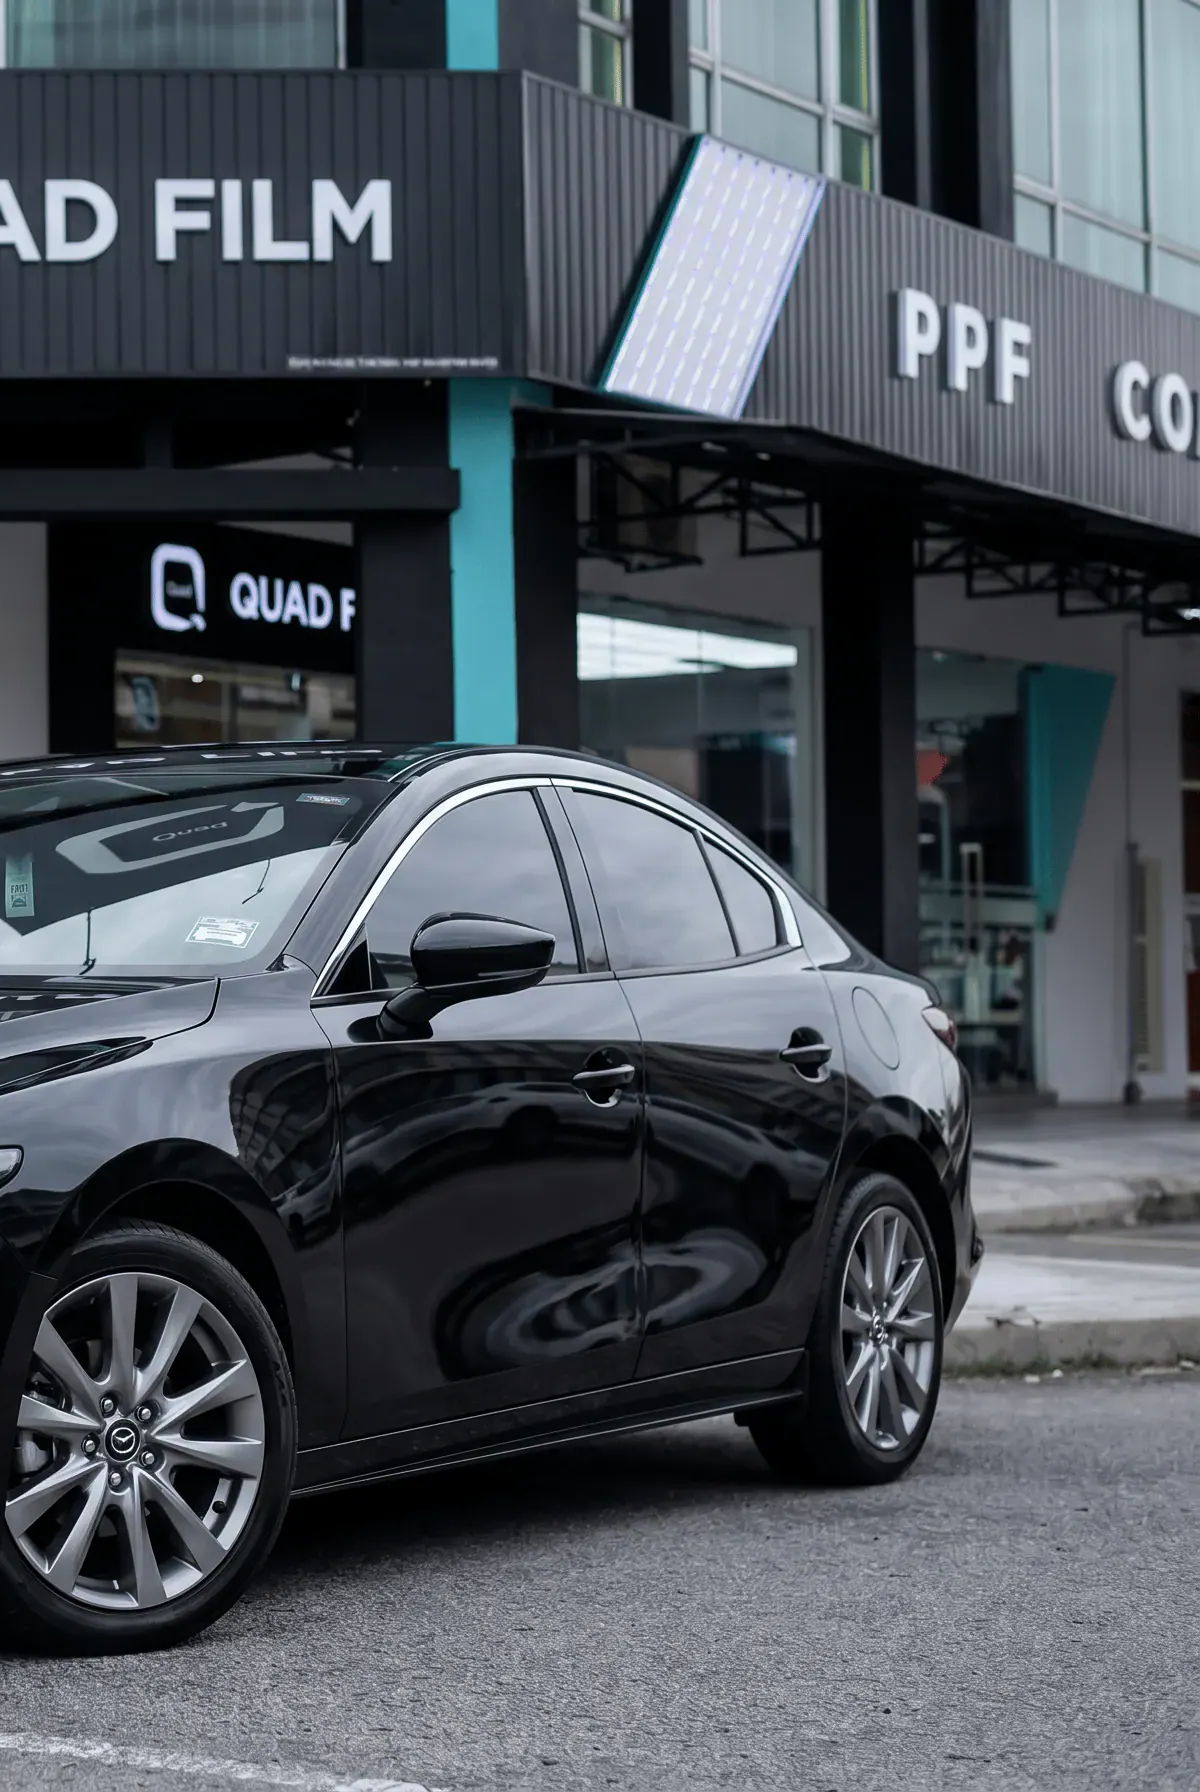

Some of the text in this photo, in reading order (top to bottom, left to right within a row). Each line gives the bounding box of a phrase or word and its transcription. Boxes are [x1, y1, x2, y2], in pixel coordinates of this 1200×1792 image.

[155, 179, 392, 261] FILM
[897, 287, 1200, 458] PPF CO
[230, 572, 334, 630] QUAD
